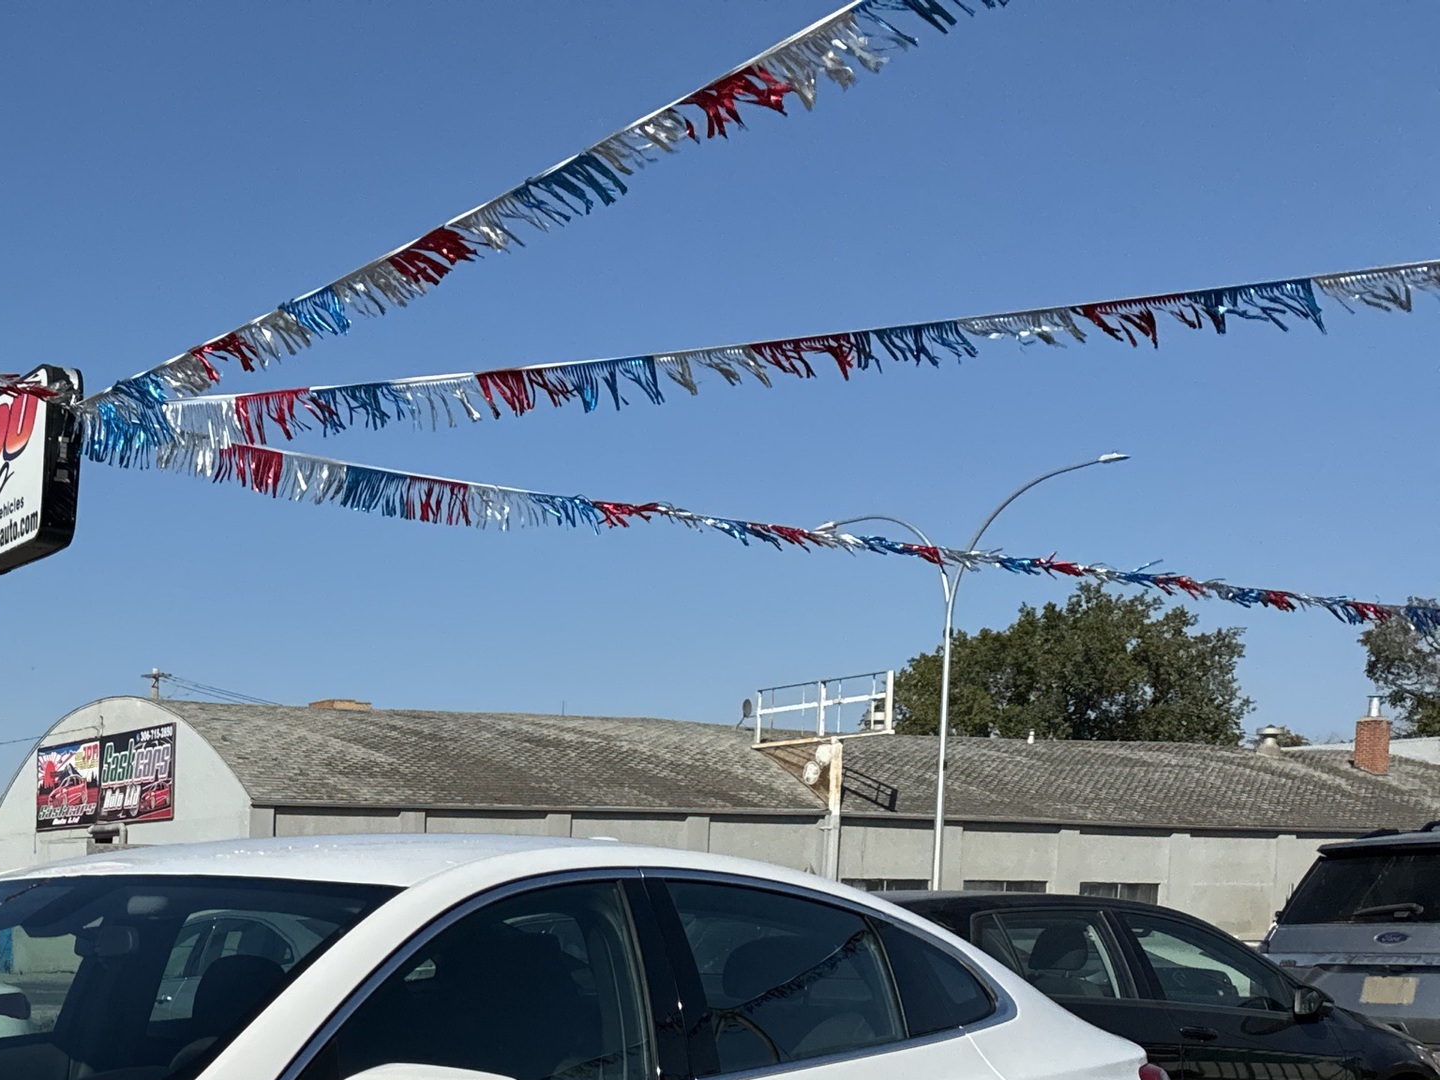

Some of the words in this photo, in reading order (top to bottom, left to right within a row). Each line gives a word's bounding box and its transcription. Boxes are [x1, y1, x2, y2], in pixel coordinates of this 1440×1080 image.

[101, 738, 172, 788] Saskcars
[103, 788, 124, 811] Auto
[124, 784, 140, 809] Ltd
